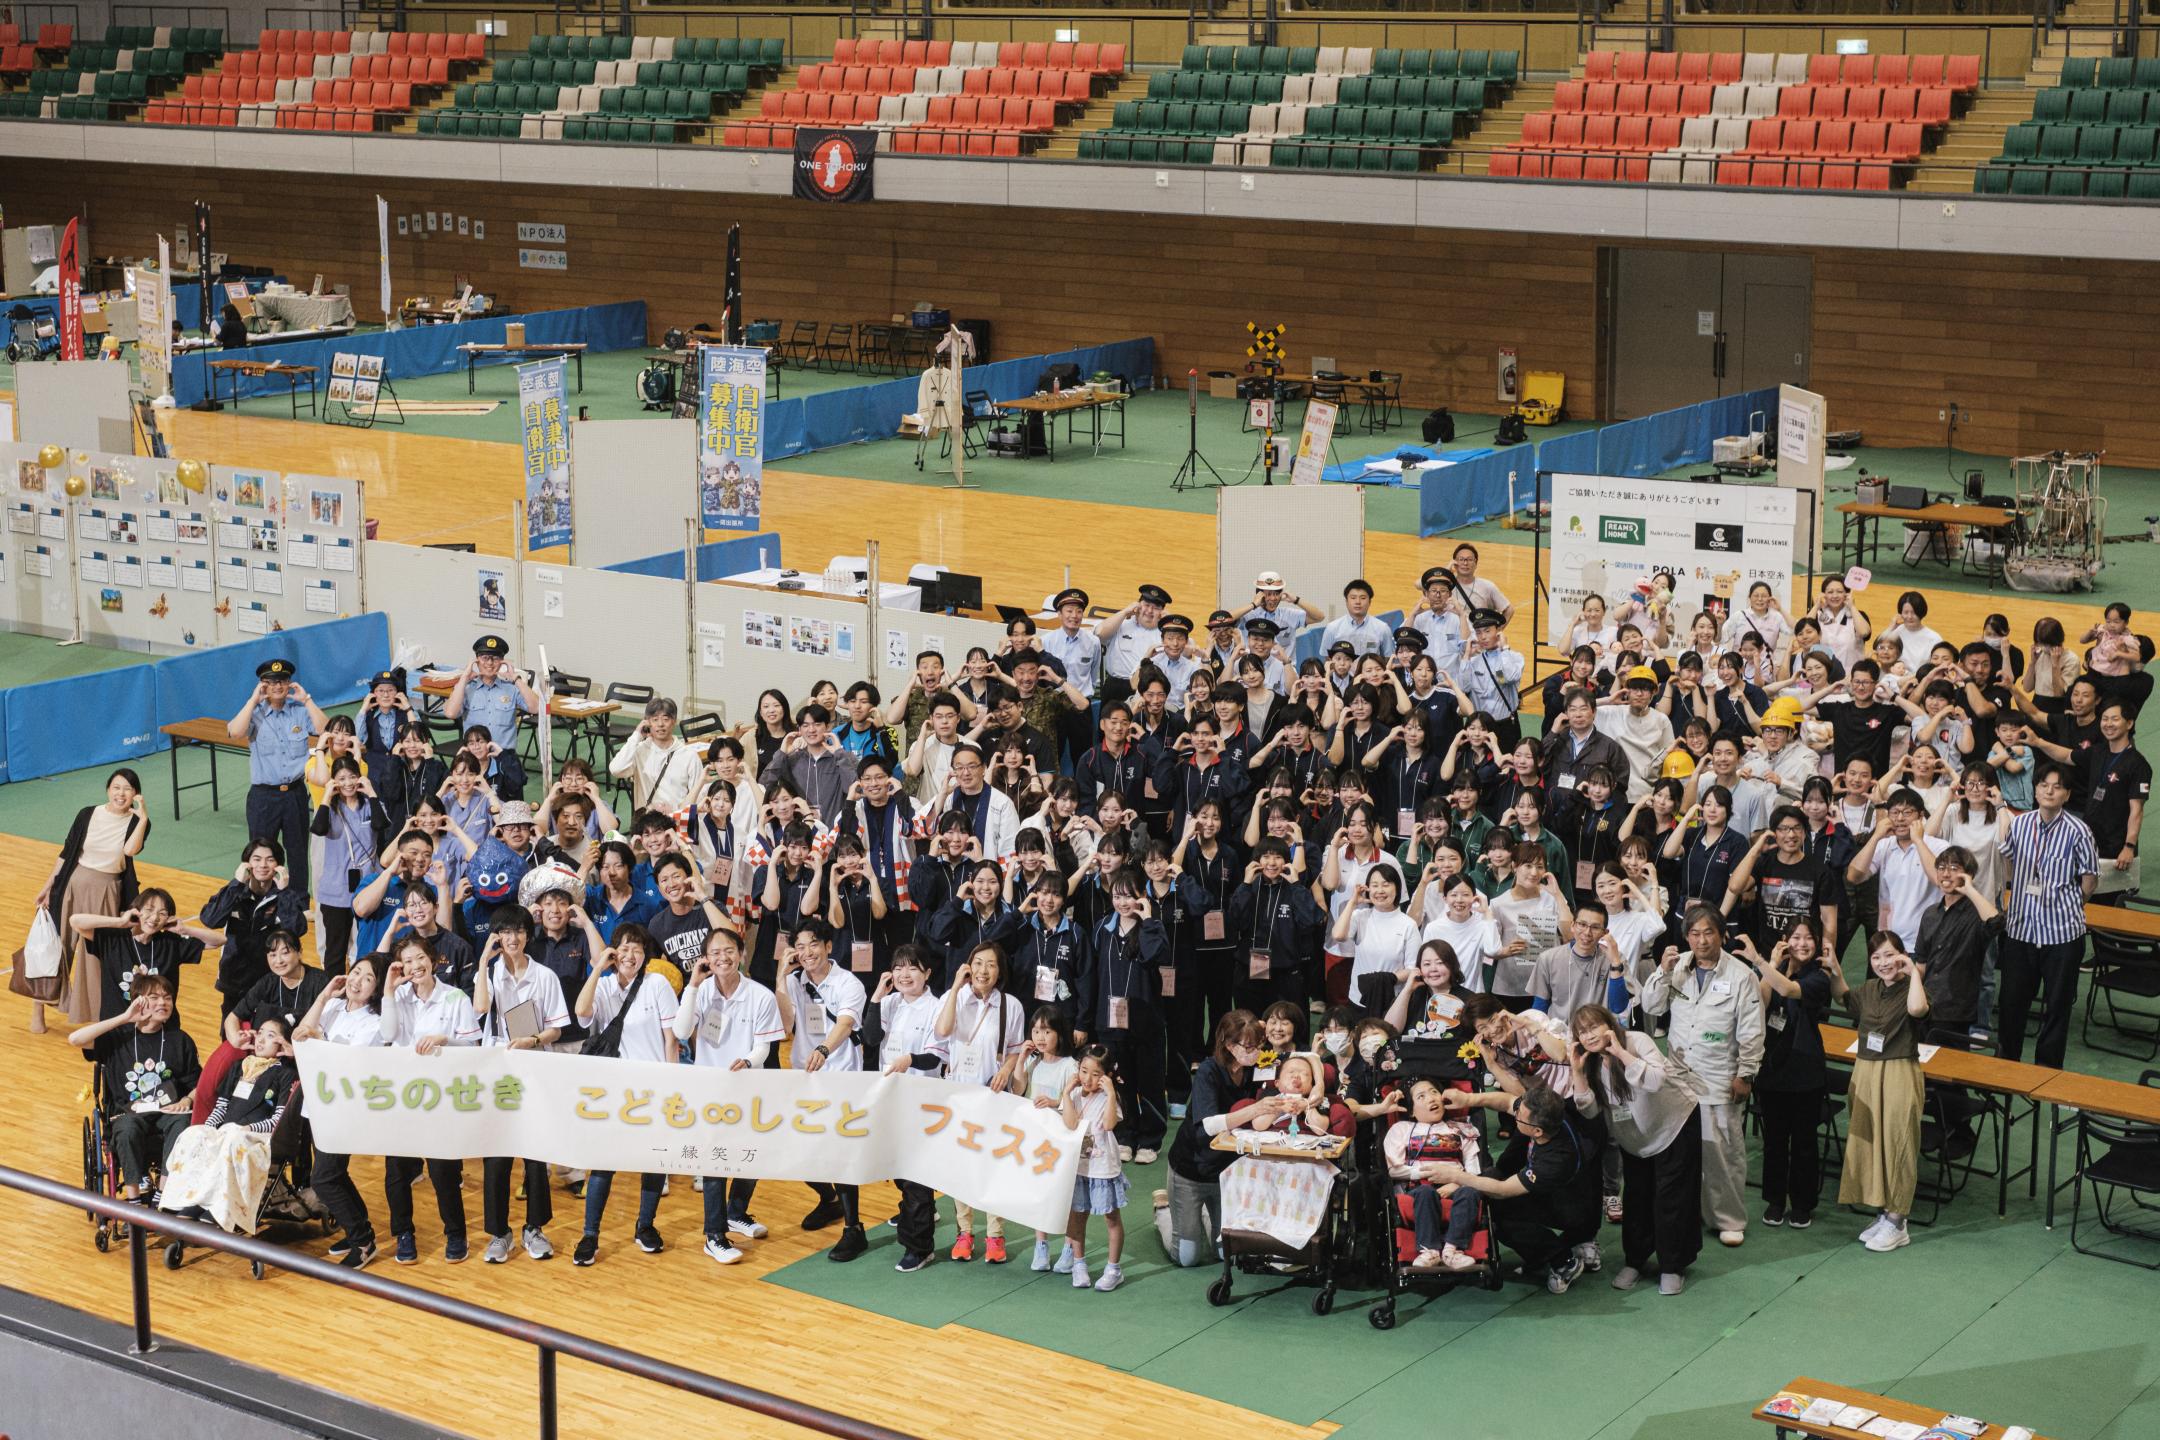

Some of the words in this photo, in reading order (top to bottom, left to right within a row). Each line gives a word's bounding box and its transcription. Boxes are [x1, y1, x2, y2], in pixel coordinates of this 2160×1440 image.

[799, 160, 821, 170] ONE
[519, 226, 565, 239] NPO法人
[709, 356, 762, 375] 陸海空
[707, 382, 734, 456] 募集中
[735, 384, 759, 458] 自衛官
[1607, 531, 1627, 539] HOME
[1747, 538, 1770, 546] NATURAL
[1652, 565, 1686, 576] POLA
[663, 927, 709, 956] CINCINNAT
[314, 1070, 526, 1113] いちのせき
[920, 1102, 1063, 1175] フェスタ
[651, 1144, 758, 1163] 一縁笑万
